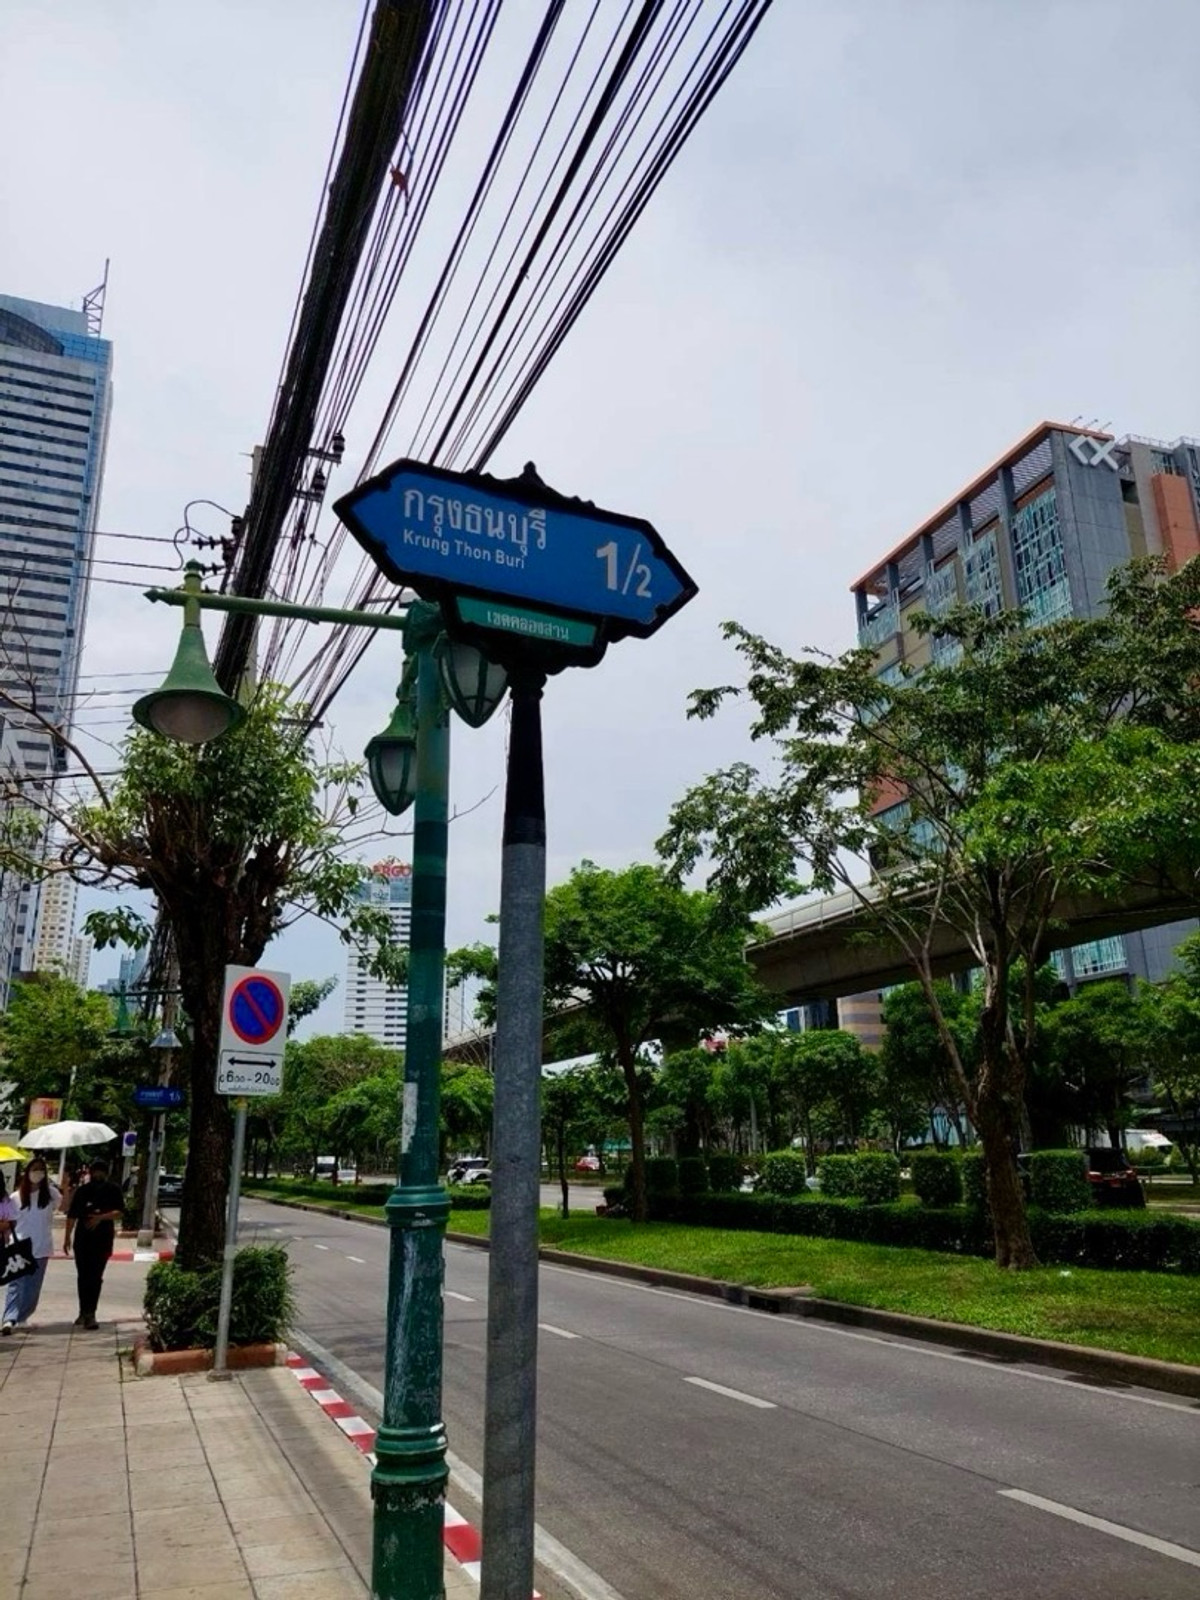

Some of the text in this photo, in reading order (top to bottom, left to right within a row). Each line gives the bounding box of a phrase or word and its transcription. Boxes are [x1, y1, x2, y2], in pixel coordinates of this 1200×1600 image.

[403, 487, 546, 557] กรุงธนบุรี
[403, 528, 525, 570] Krung Thon Buri
[596, 540, 652, 599] 1/2
[487, 610, 569, 642] เขตคลองสาน
